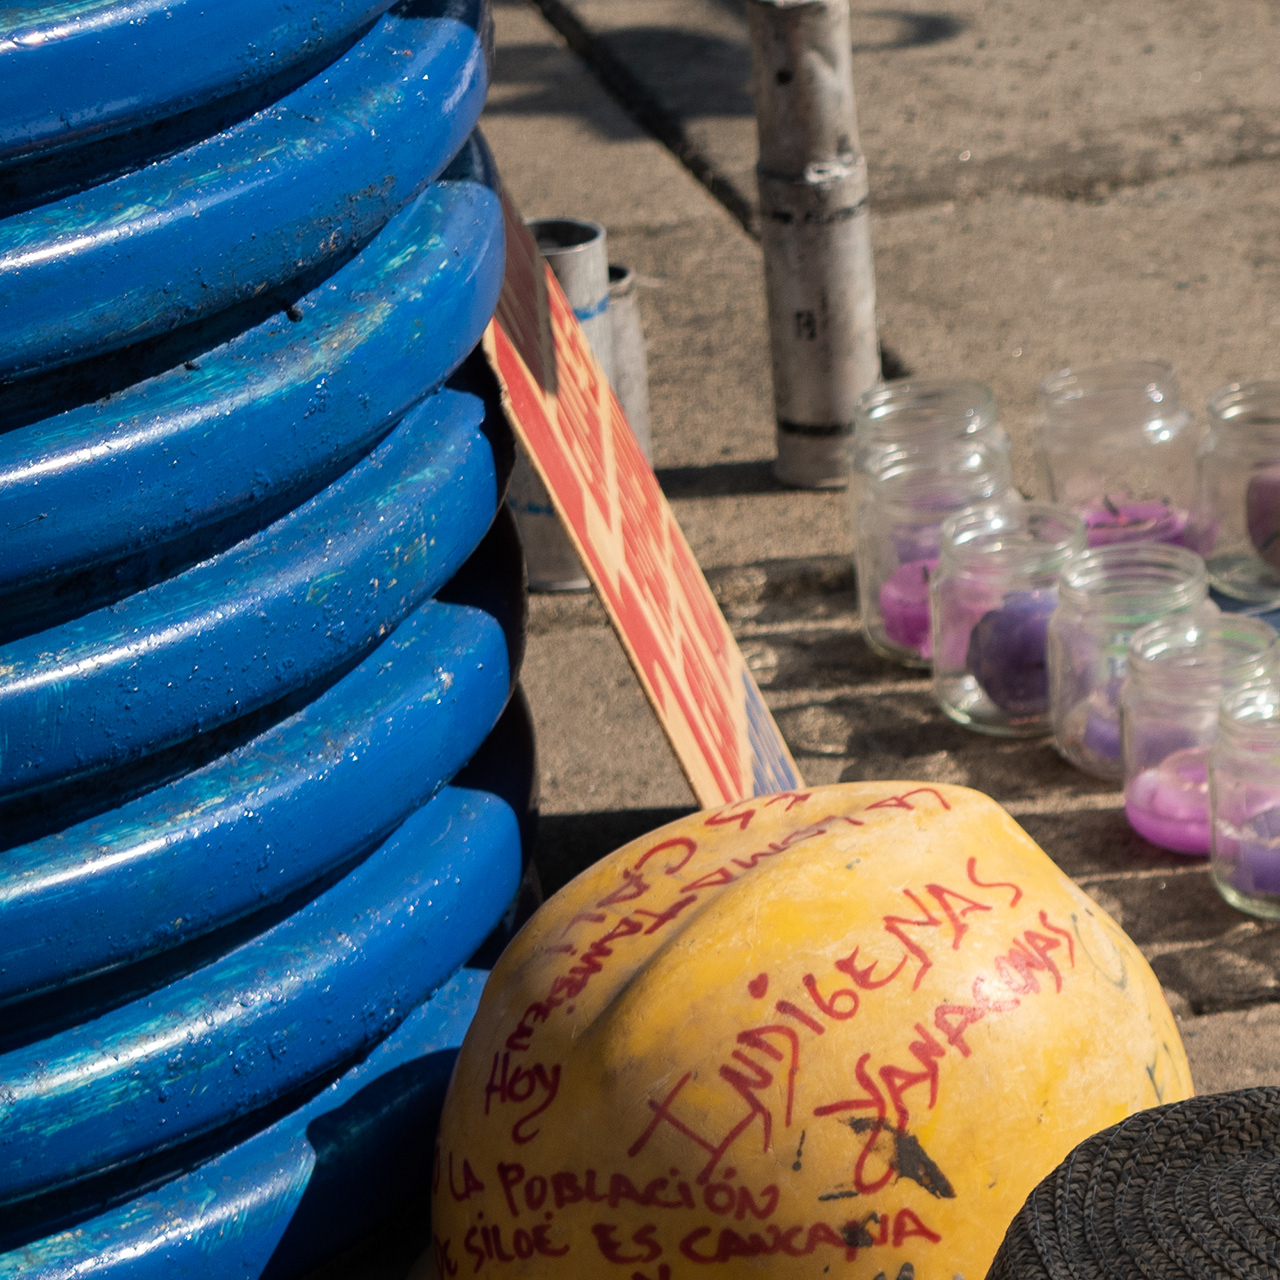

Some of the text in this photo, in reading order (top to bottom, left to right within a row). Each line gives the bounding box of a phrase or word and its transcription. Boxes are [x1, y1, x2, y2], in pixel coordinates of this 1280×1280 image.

[545, 836, 699, 957] CALI
[449, 1151, 485, 1203] LA
[496, 1161, 781, 1220] POBLACIÓN
[591, 1222, 663, 1264] ES
